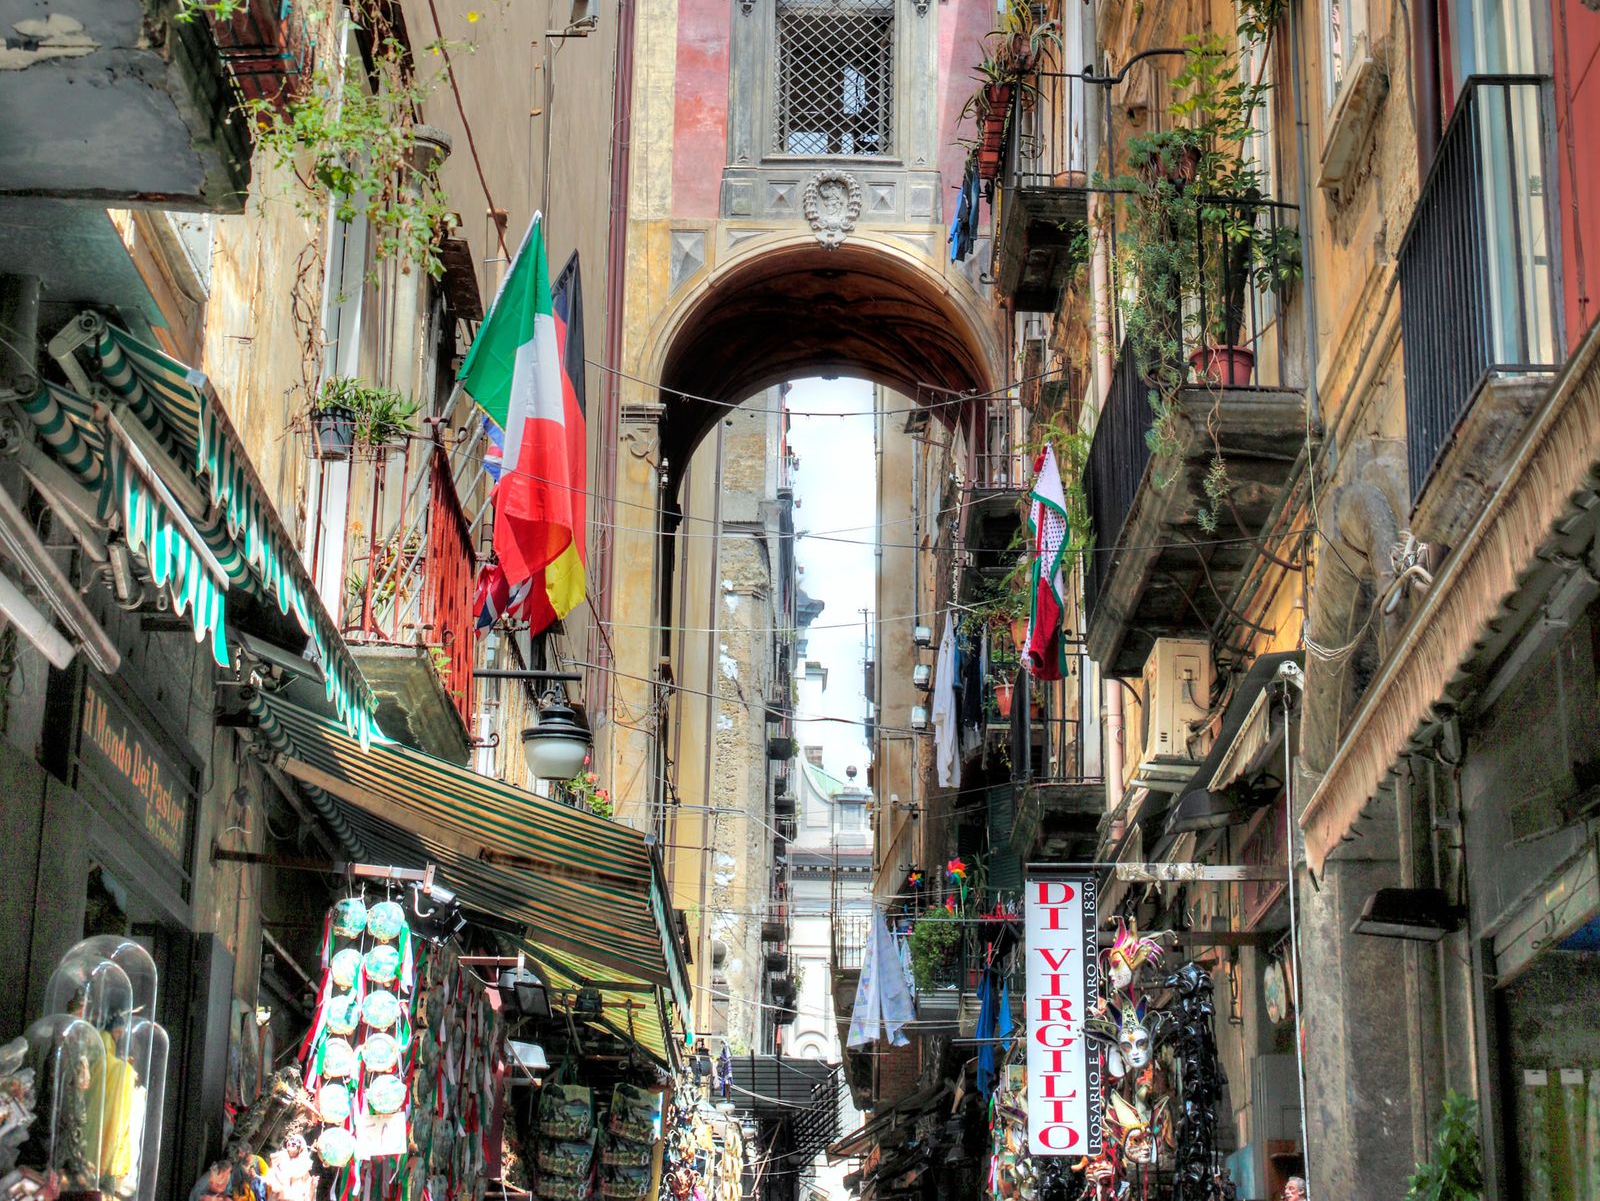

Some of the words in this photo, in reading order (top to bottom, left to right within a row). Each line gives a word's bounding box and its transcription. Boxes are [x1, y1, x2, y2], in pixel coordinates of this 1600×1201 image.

[94, 696, 131, 778] Mondo
[132, 740, 152, 798] Dei
[150, 761, 186, 833] Pastori
[1033, 881, 1075, 931] DI
[1083, 882, 1096, 918] 1830
[1086, 925, 1096, 957] DAL
[1086, 962, 1099, 1051] GNARO
[1033, 947, 1080, 1150] VIRGILIO
[1088, 1057, 1099, 1065] E
[1089, 1071, 1102, 1149] ROSARIO
